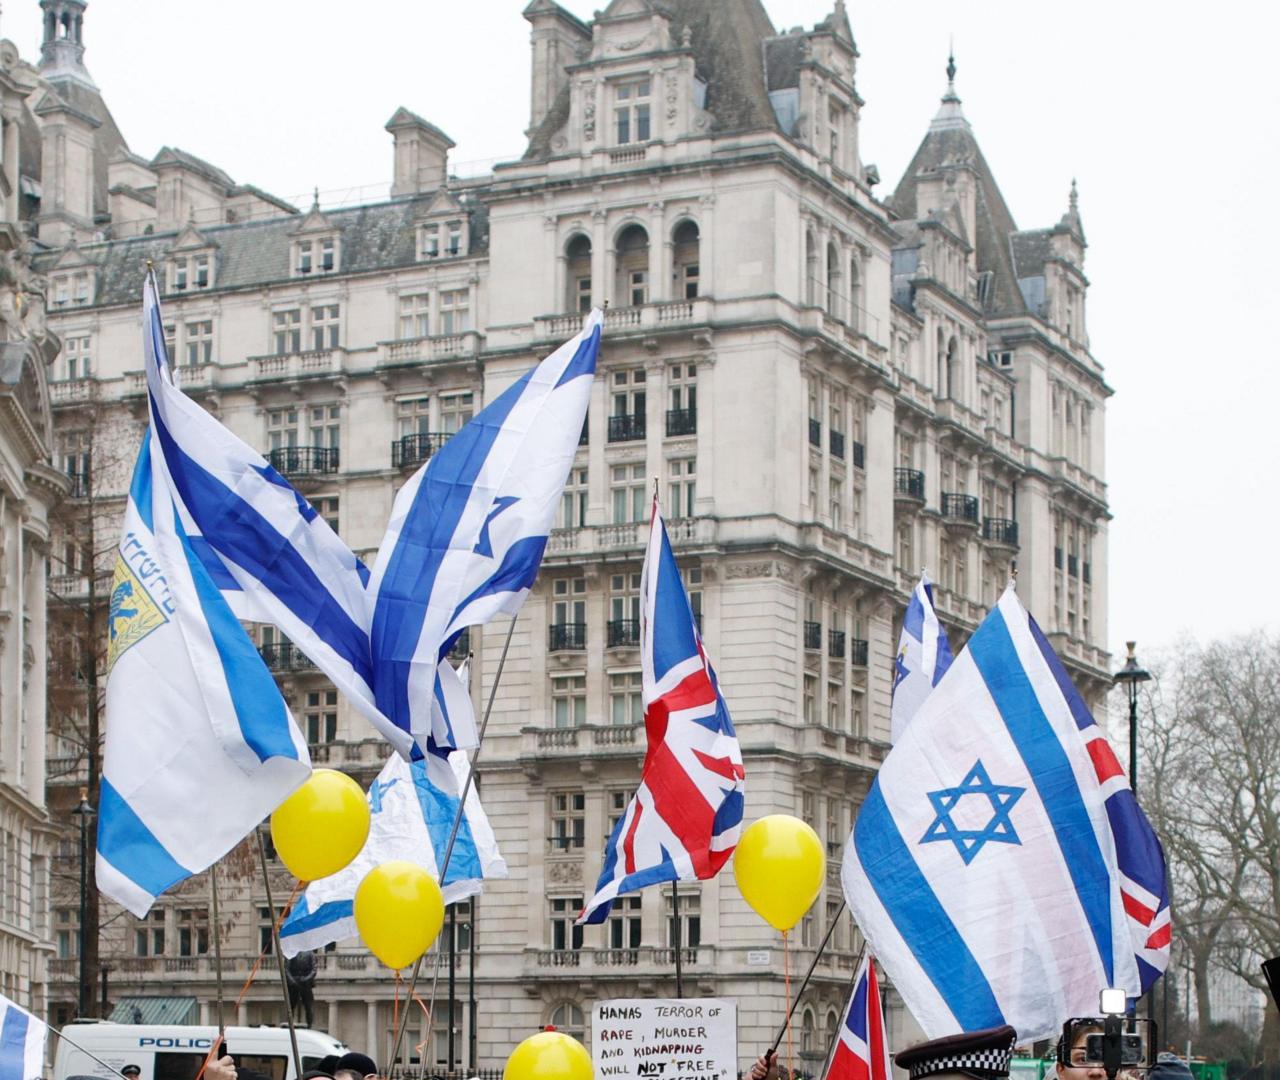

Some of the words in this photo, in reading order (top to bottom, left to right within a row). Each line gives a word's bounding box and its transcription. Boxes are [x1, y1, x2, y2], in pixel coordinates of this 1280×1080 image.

[654, 1006, 703, 1018] TERROR
[709, 1008, 721, 1017] OF
[654, 1027, 707, 1039] MURDER
[139, 1037, 216, 1048] POLIC
[601, 1048, 624, 1059] AND
[633, 1044, 704, 1058] KIDNAPPING
[601, 1065, 629, 1076] WILL
[637, 1060, 667, 1076] NOT
